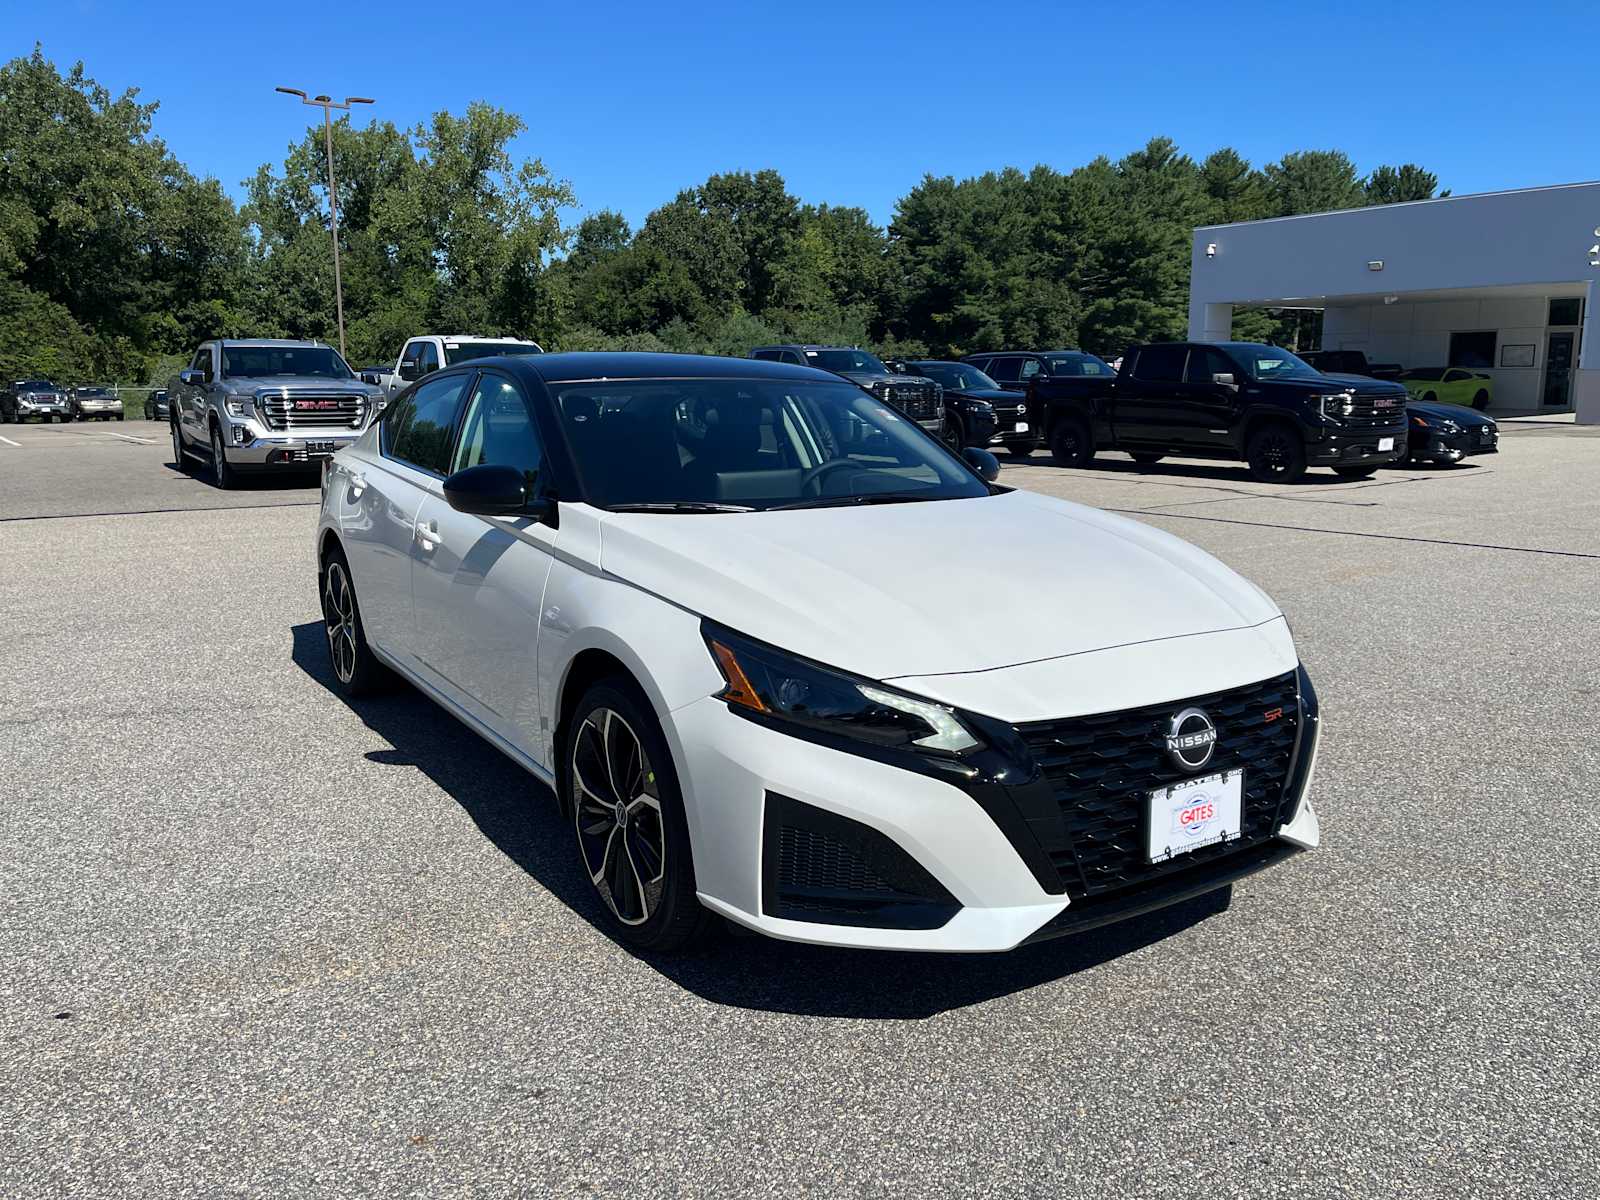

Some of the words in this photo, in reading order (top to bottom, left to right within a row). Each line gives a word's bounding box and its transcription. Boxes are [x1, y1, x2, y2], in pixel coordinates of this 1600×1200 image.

[295, 401, 338, 409] GMC
[1264, 708, 1282, 722] SR
[1168, 729, 1217, 750] NISSAN
[1180, 804, 1213, 825] GATES
